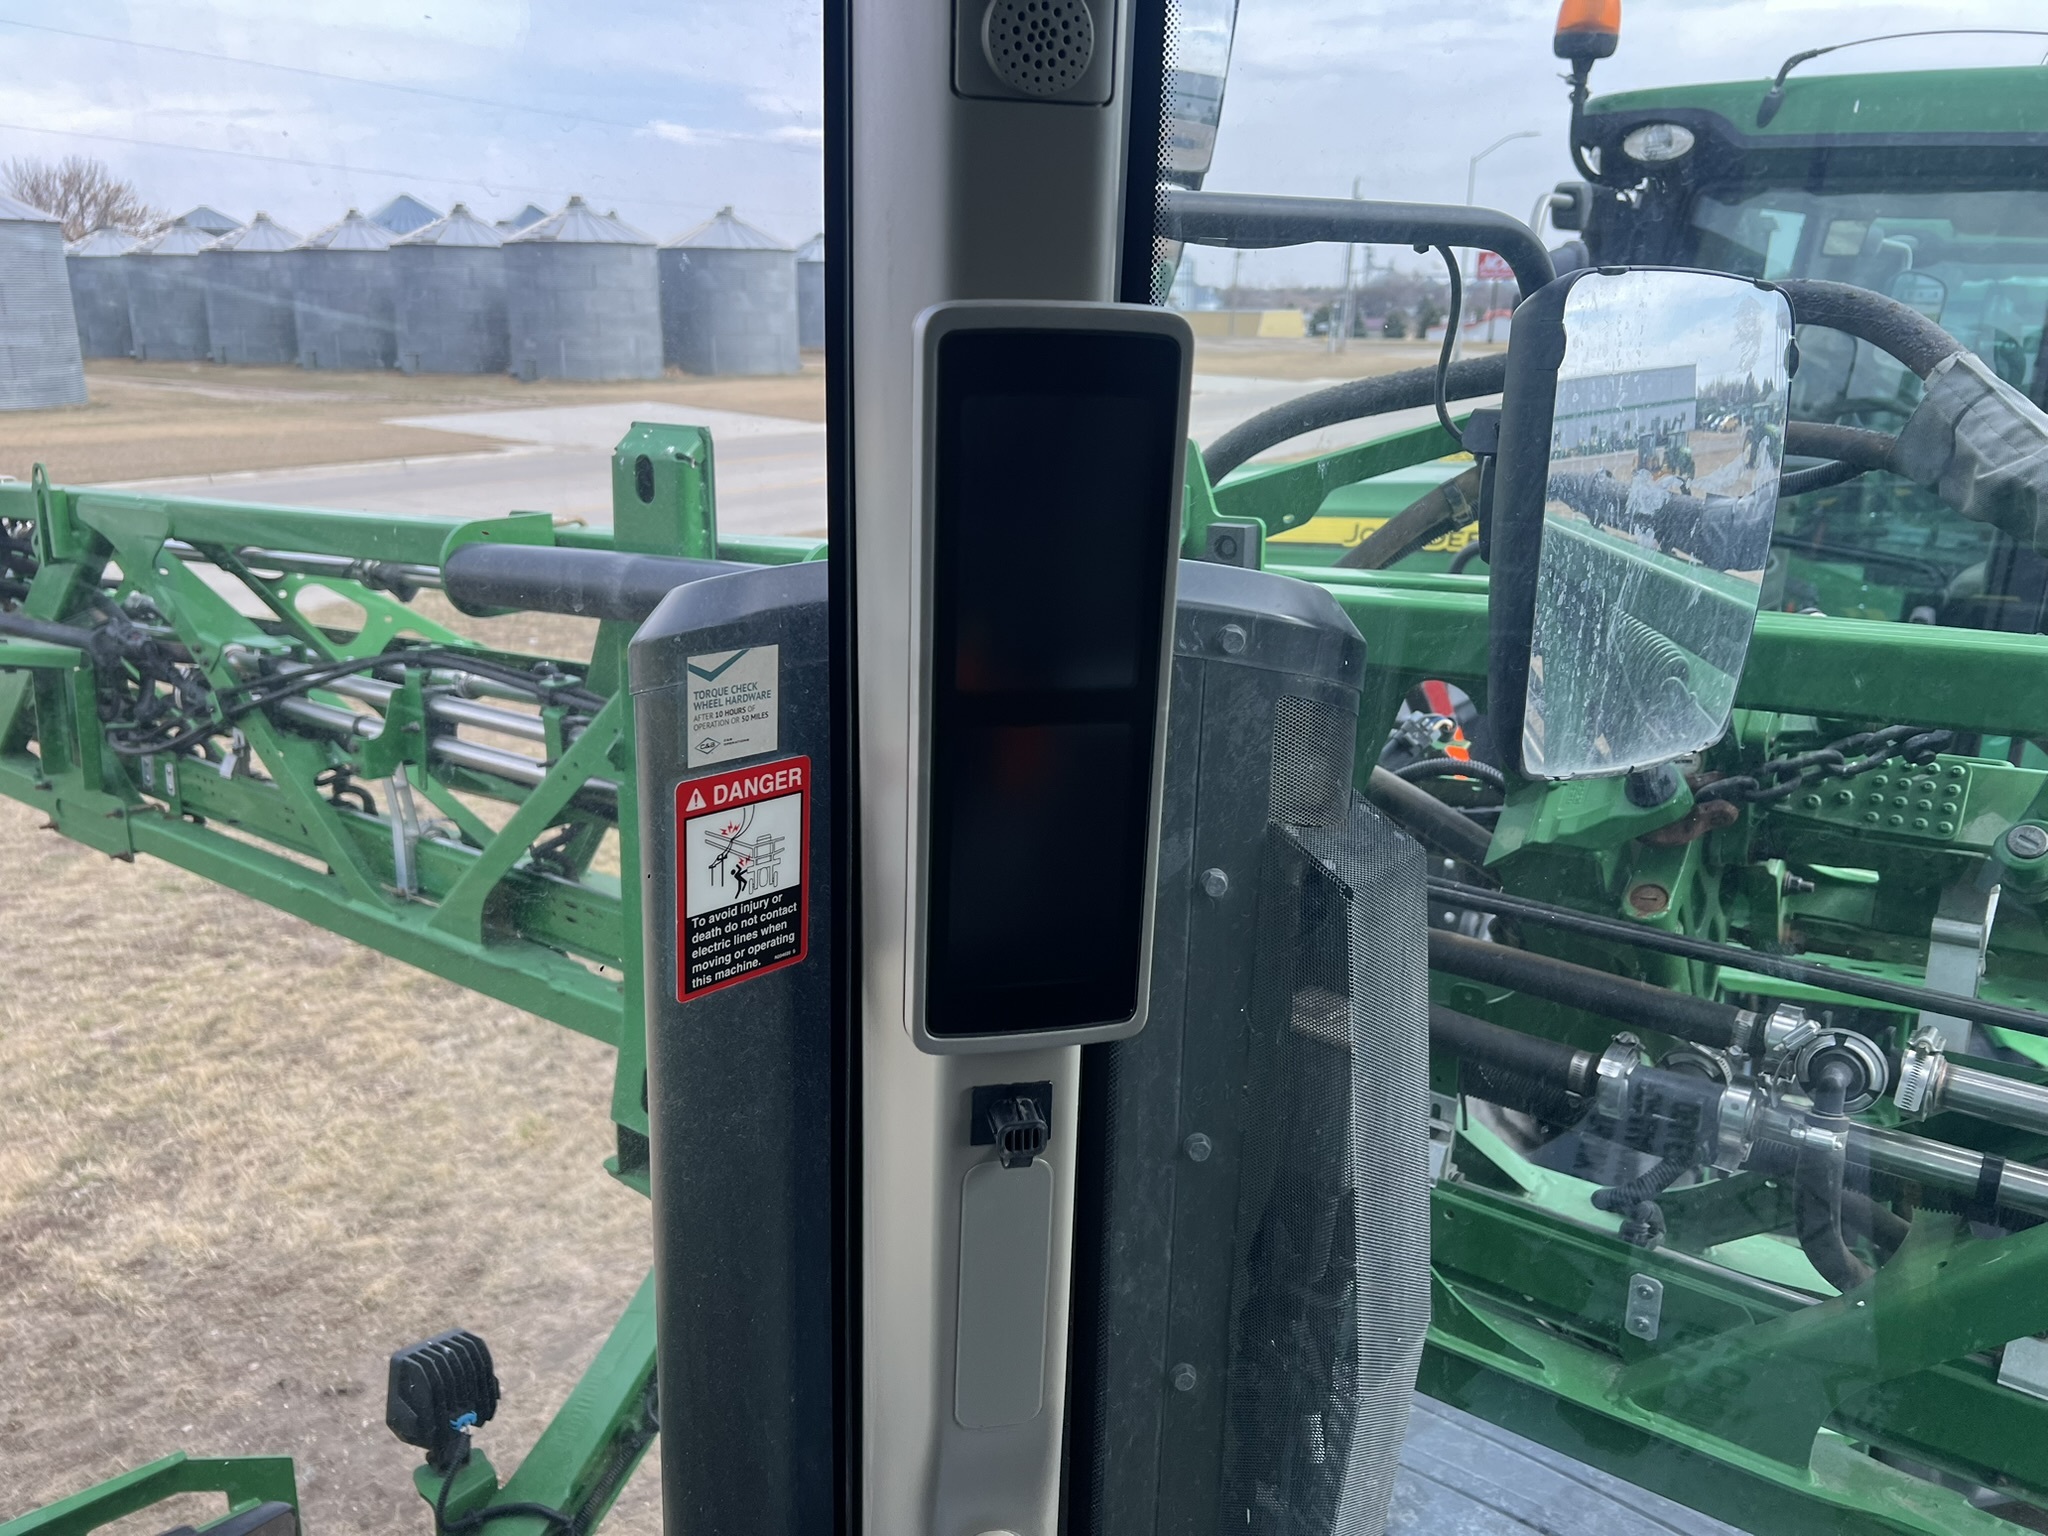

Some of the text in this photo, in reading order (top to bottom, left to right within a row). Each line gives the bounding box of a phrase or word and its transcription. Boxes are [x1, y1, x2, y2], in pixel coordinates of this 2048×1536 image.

[693, 681, 758, 700] TORQUE CHECK
[693, 689, 772, 711] WHEEL HARDWARE
[693, 704, 756, 723] AFTER 10 HOURS OF
[693, 711, 769, 732] OPERATION OR 50 MILES
[713, 767, 802, 805] DANGER
[691, 893, 783, 929] To avoid injury or
[691, 902, 798, 944] death do not contact
[691, 921, 788, 959] electric lines when
[692, 954, 732, 974] moving
[733, 948, 746, 960] or
[747, 932, 796, 955] operating
[691, 958, 762, 989] this machine.
